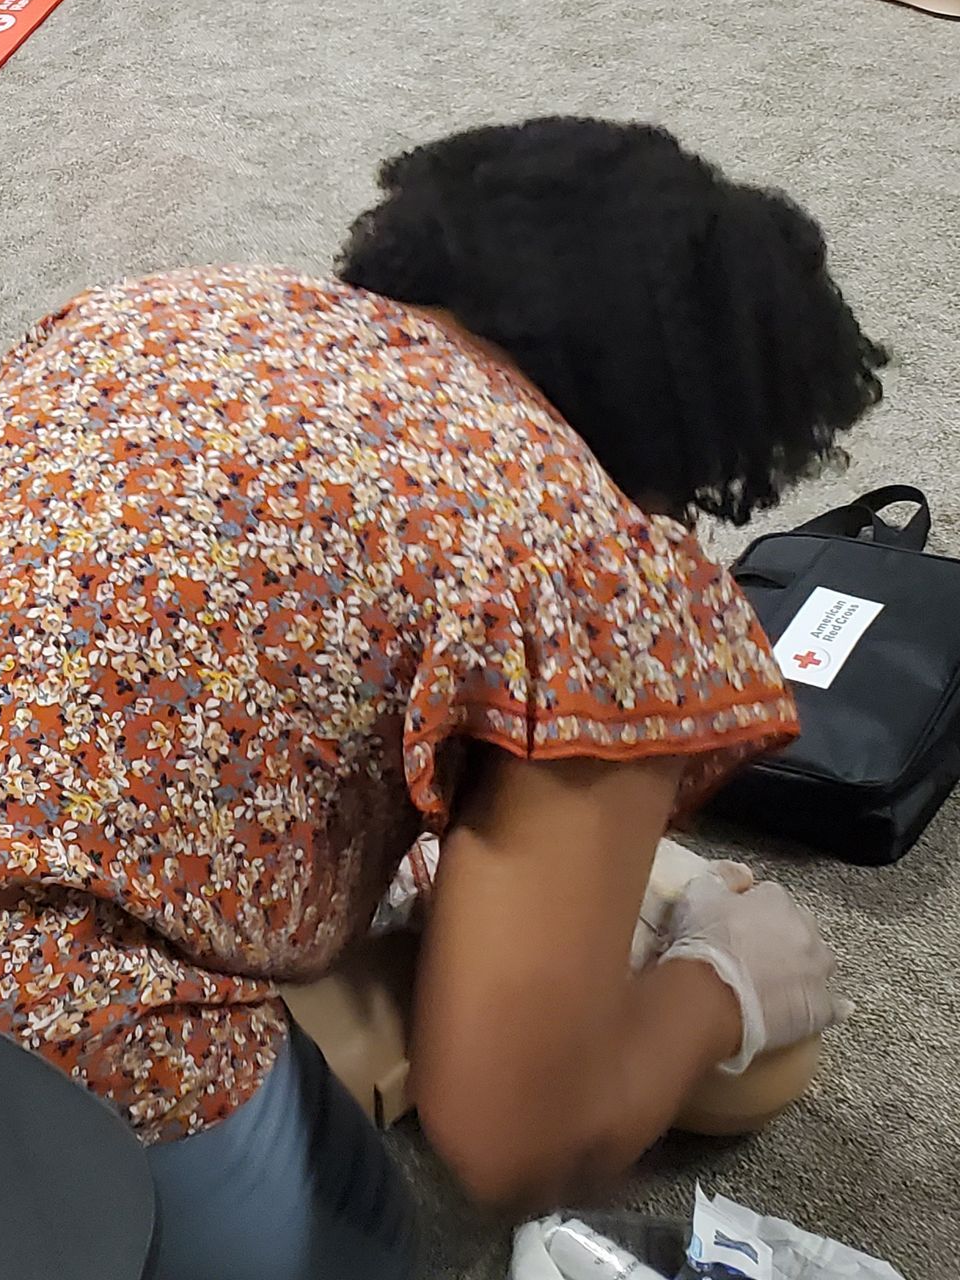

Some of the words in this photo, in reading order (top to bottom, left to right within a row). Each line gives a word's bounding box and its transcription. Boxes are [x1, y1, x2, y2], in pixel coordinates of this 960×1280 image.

[810, 600, 848, 639] American
[822, 624, 843, 642] Red
[836, 604, 860, 625] Cross
